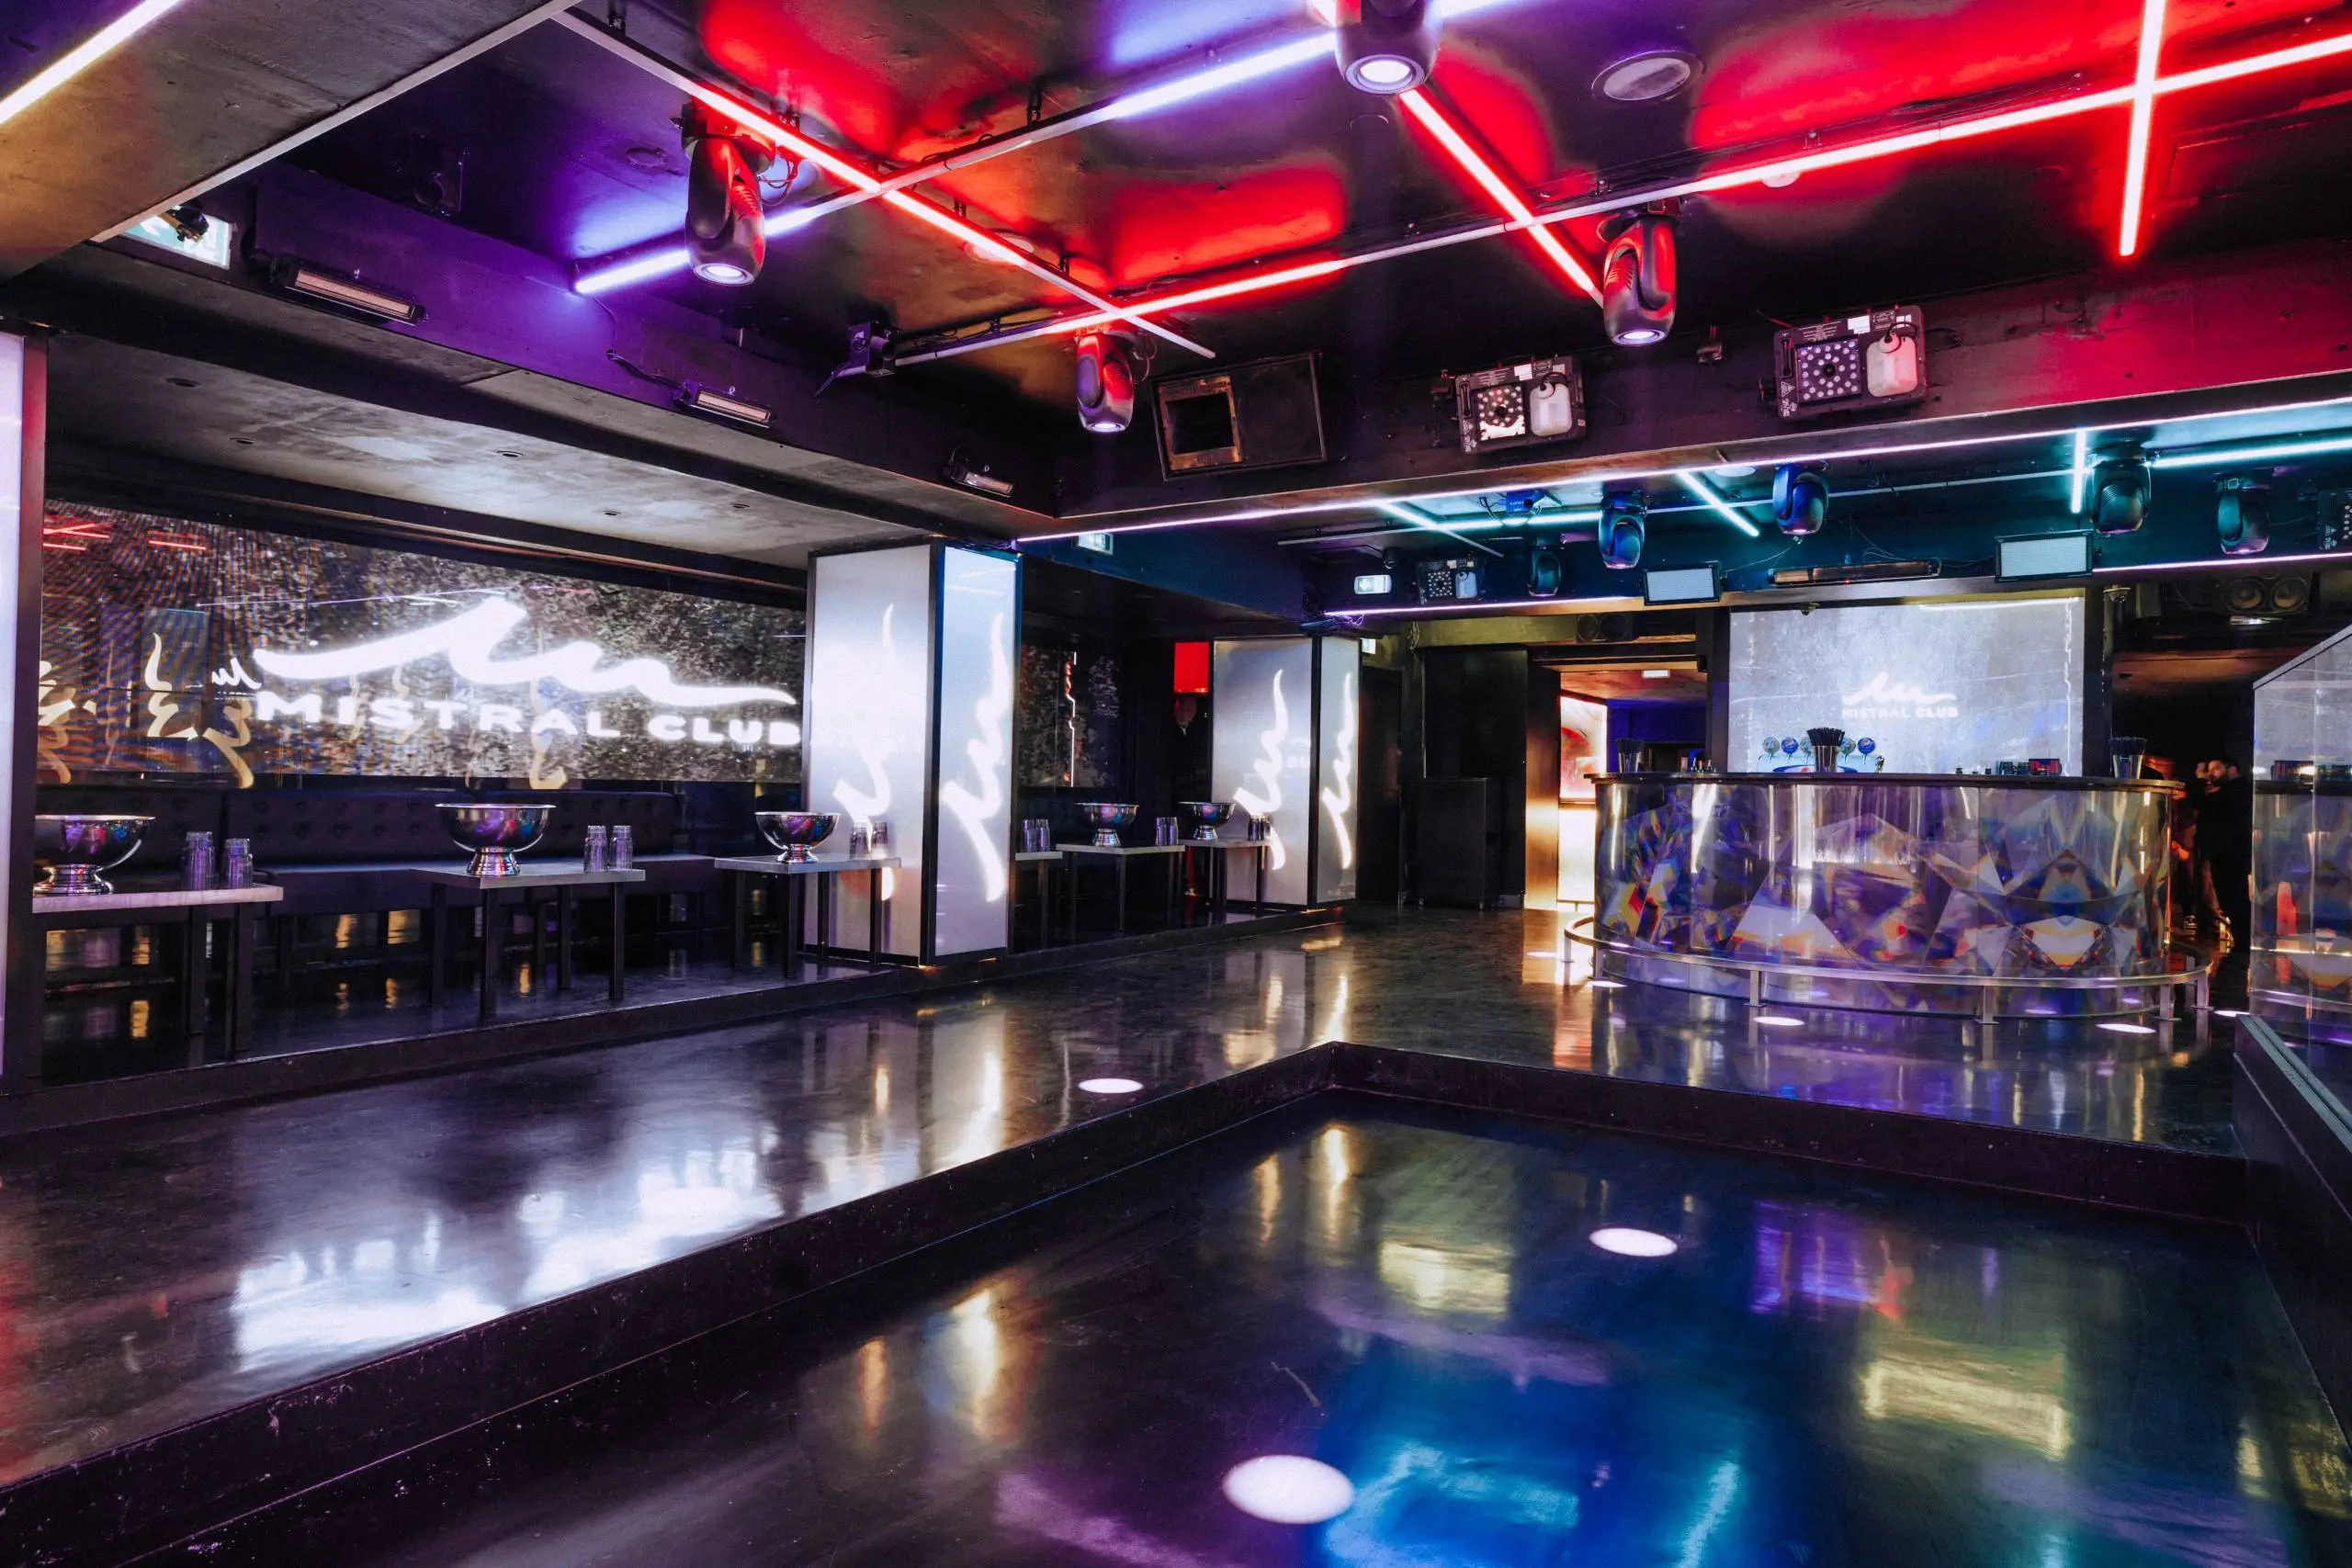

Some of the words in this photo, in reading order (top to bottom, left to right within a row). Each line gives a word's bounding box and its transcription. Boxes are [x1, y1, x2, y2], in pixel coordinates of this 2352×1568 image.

[255, 691, 621, 738] MISTRAL
[647, 714, 801, 746] CLUB
[1916, 706, 1958, 718] CLUB
